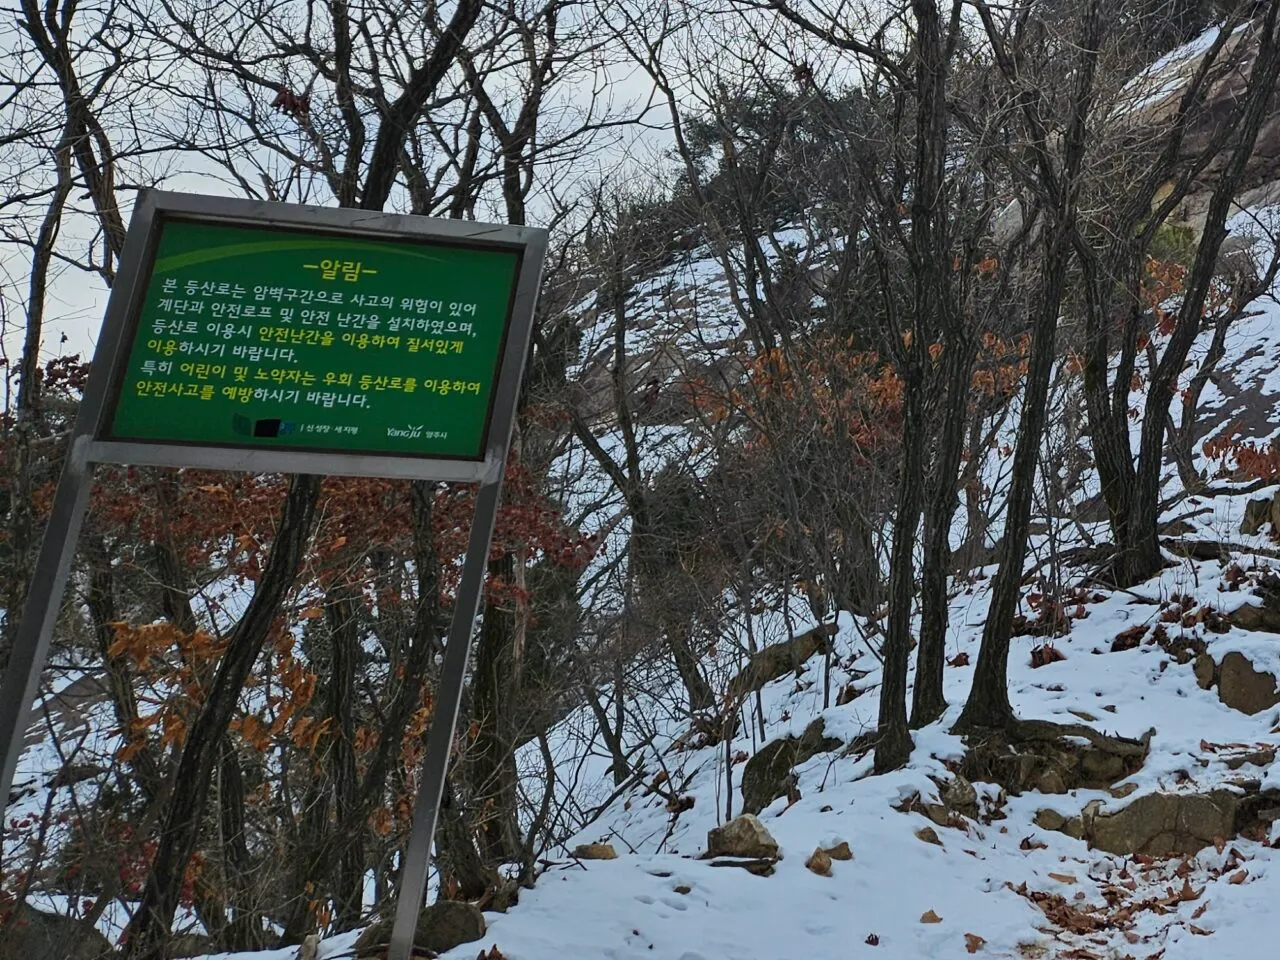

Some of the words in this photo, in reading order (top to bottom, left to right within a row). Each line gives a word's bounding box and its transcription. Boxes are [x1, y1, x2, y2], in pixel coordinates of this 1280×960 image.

[162, 278, 178, 293] 본
[184, 280, 247, 299] 등산로는
[253, 285, 344, 305] 암벽구간으로
[350, 294, 394, 309] 사고의
[400, 298, 442, 314] 위험이
[449, 302, 477, 317] 있어
[157, 298, 204, 315] 계단과
[211, 302, 272, 319] 안전로프
[280, 307, 294, 323] 및
[300, 309, 330, 326] 안전
[337, 313, 381, 330] 난간을
[387, 316, 477, 338] 설치하였으며,
[147, 339, 226, 357] 이용하시기
[232, 344, 298, 363] 바랍니다.
[152, 318, 198, 336] 등산로
[206, 322, 253, 340] 이용시
[259, 326, 335, 346] 안전난간을
[342, 332, 400, 350] 이용하여
[407, 337, 464, 355] 질서있게
[136, 380, 215, 401] 안전사고를
[222, 385, 300, 403] 예방하시기
[306, 390, 371, 409] 바랍니다.
[140, 360, 173, 376] 특히
[180, 362, 226, 380] 어린이
[233, 366, 248, 382] 및
[254, 367, 317, 386] 노약자는
[323, 371, 353, 387] 우회
[358, 375, 417, 393] 등산로를
[424, 378, 481, 396] 이용하여
